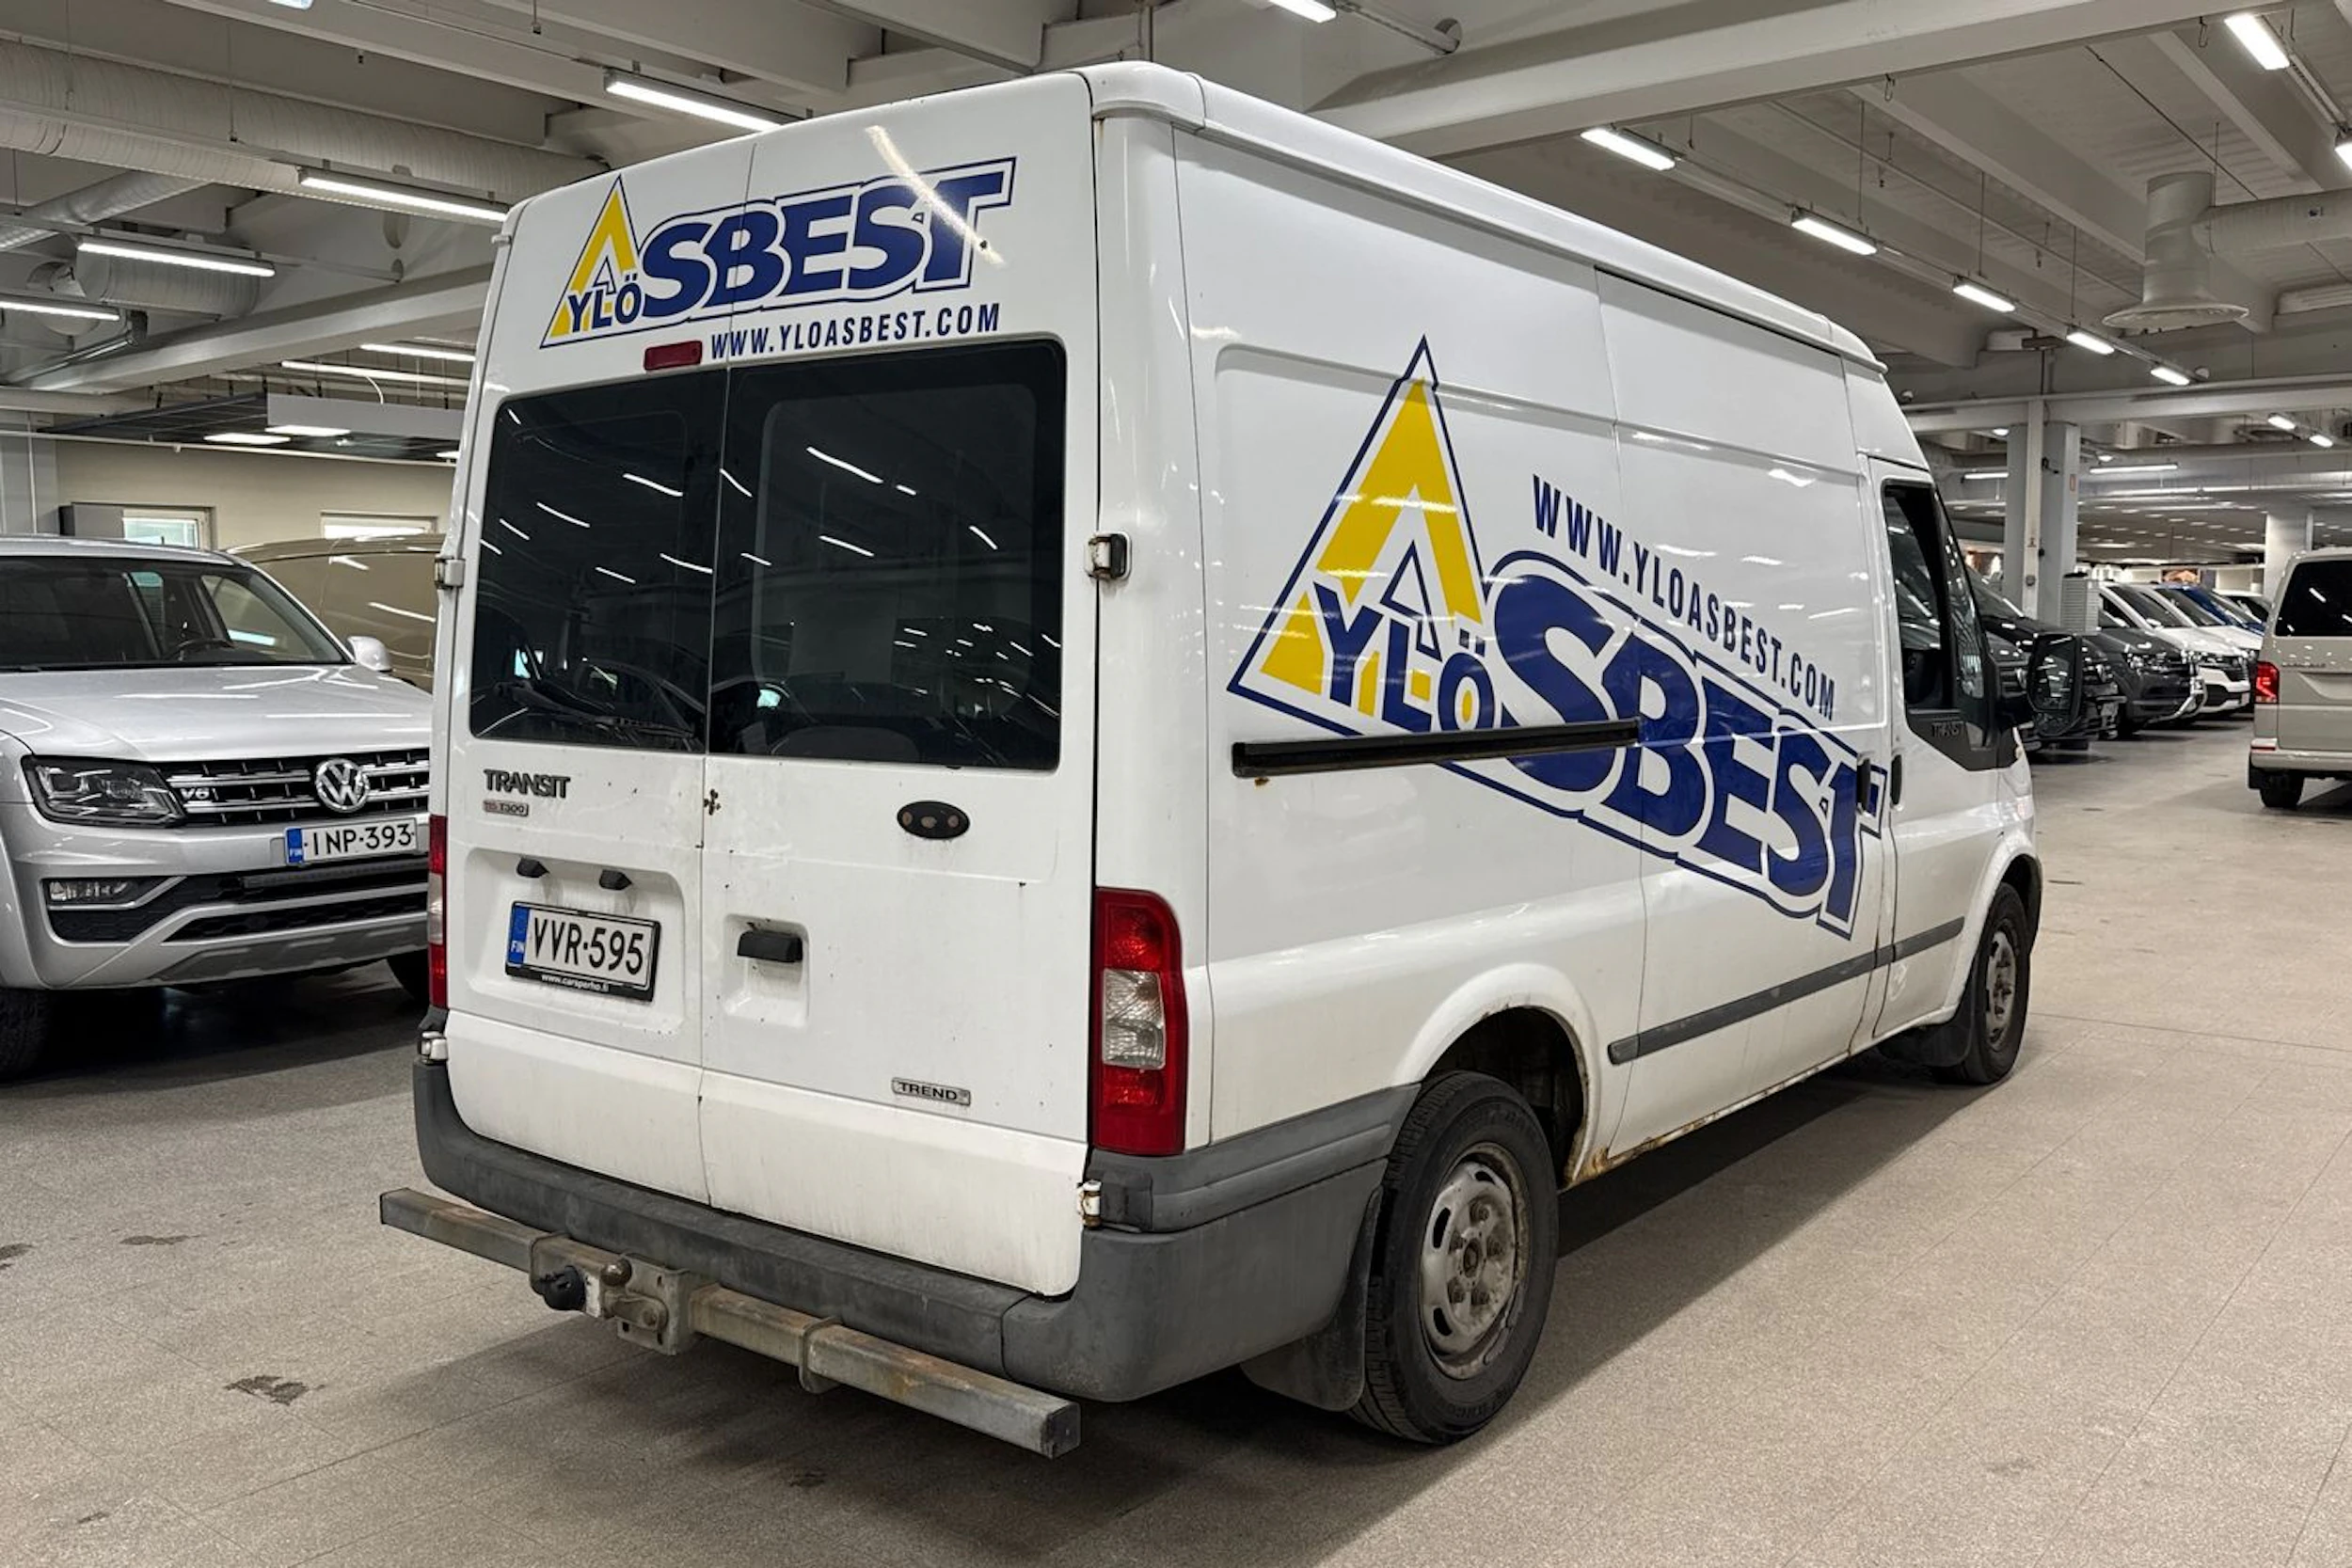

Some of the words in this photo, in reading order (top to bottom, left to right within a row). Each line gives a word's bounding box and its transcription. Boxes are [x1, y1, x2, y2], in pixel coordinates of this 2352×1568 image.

[567, 273, 642, 333] YLÖ
[710, 302, 1000, 360] WWW.YLOASBEST.COM
[1532, 473, 1836, 721] WWW.YLOASBEST.COM
[1313, 579, 1496, 734] YLÖ
[179, 786, 210, 800] V6
[483, 768, 571, 799] TRANSIT
[534, 917, 644, 975] VVR-595
[898, 1082, 958, 1101] TREND
